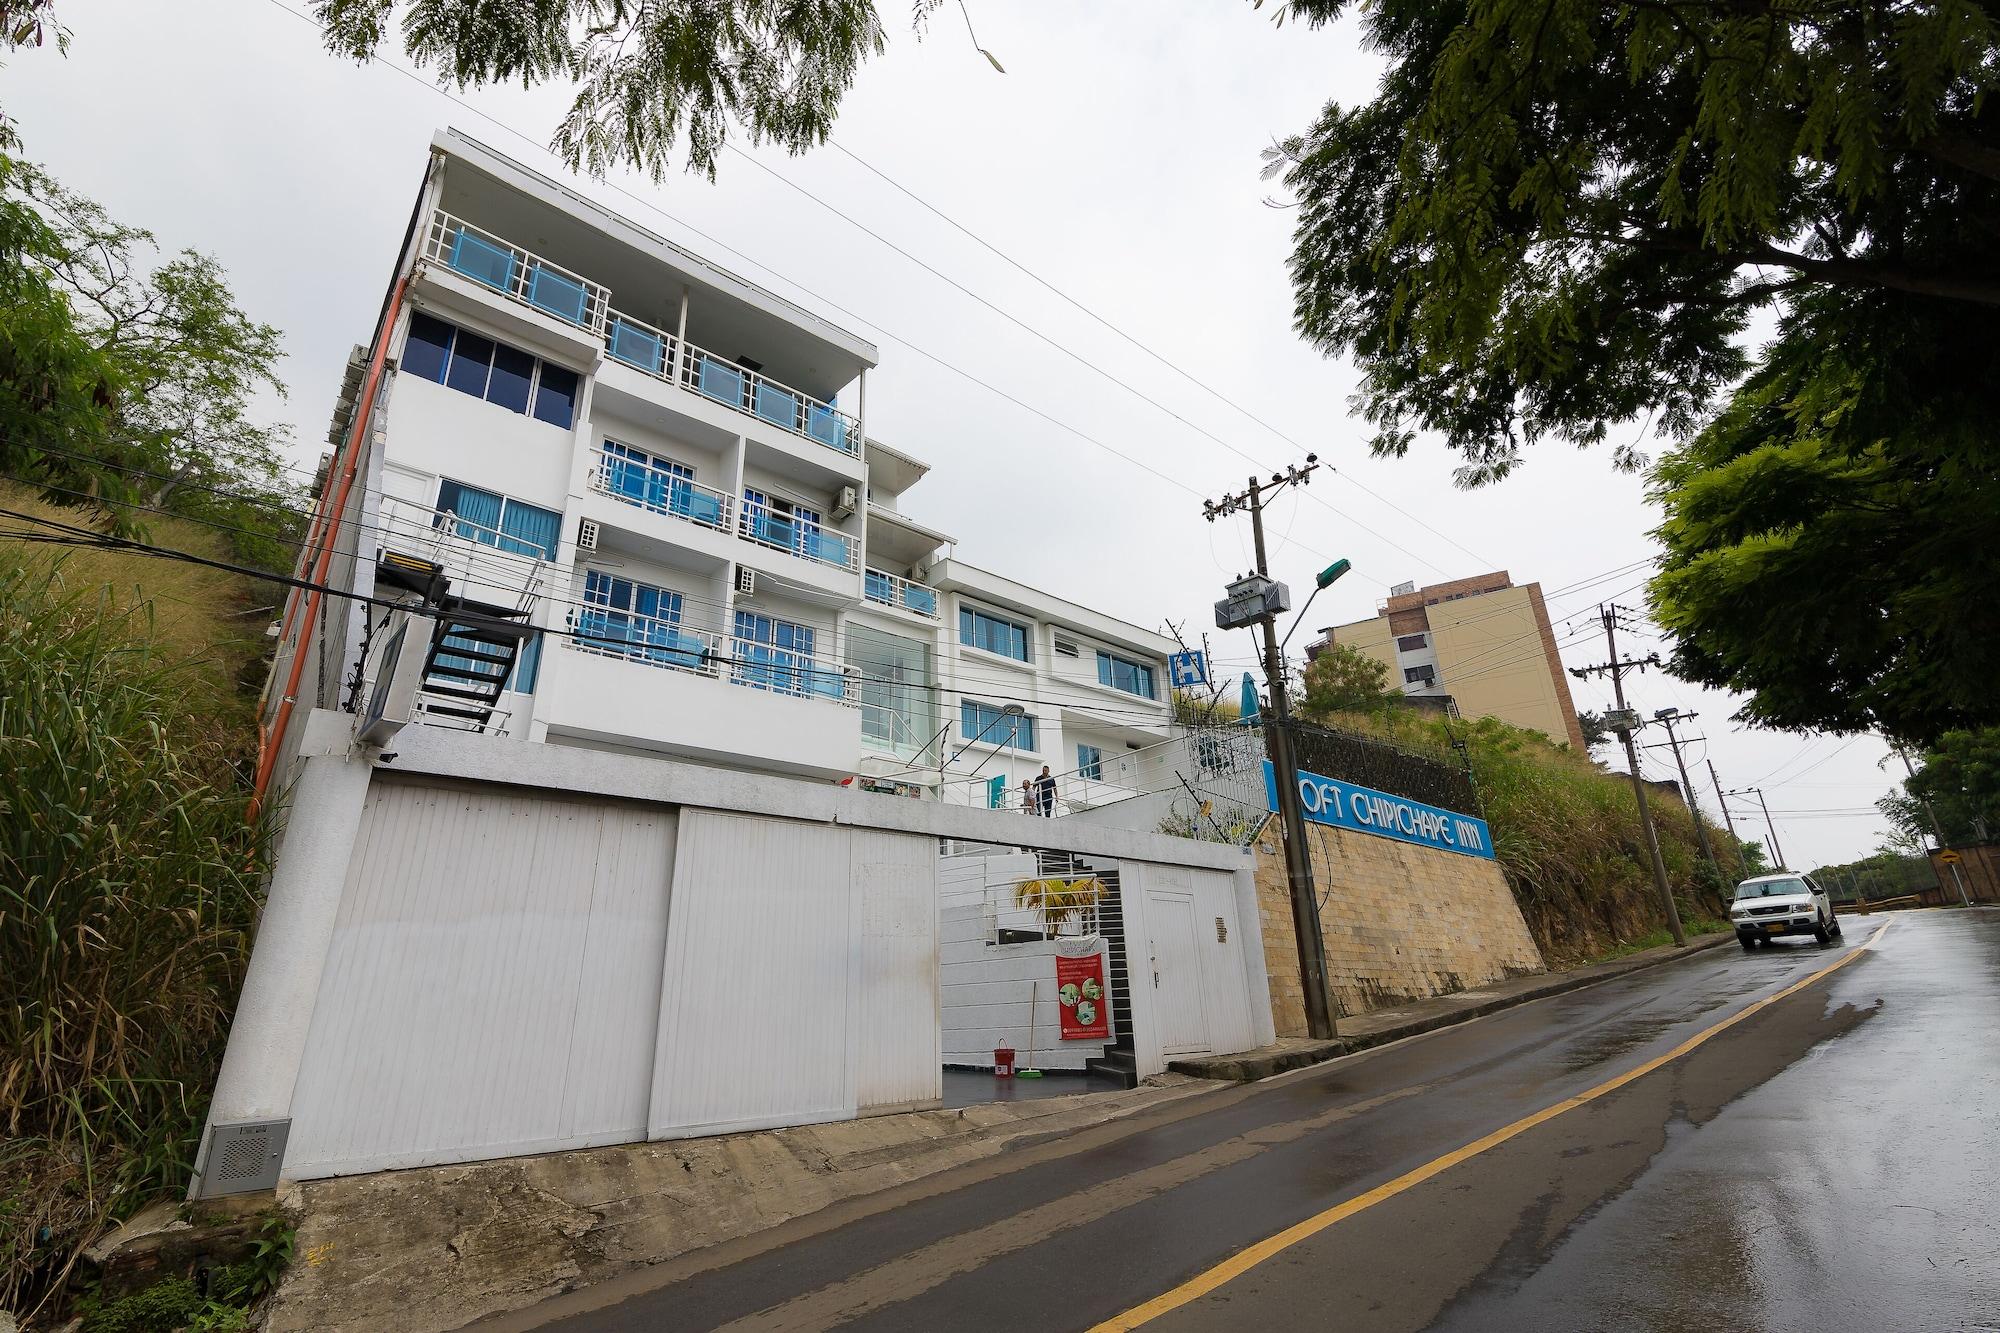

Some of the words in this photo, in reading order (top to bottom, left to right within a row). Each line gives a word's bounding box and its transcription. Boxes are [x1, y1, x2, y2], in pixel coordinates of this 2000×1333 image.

[1173, 653, 1202, 684] H
[1298, 778, 1343, 818] OFT
[1350, 792, 1455, 845] CHIPICHAPE
[1454, 819, 1484, 851] INN
